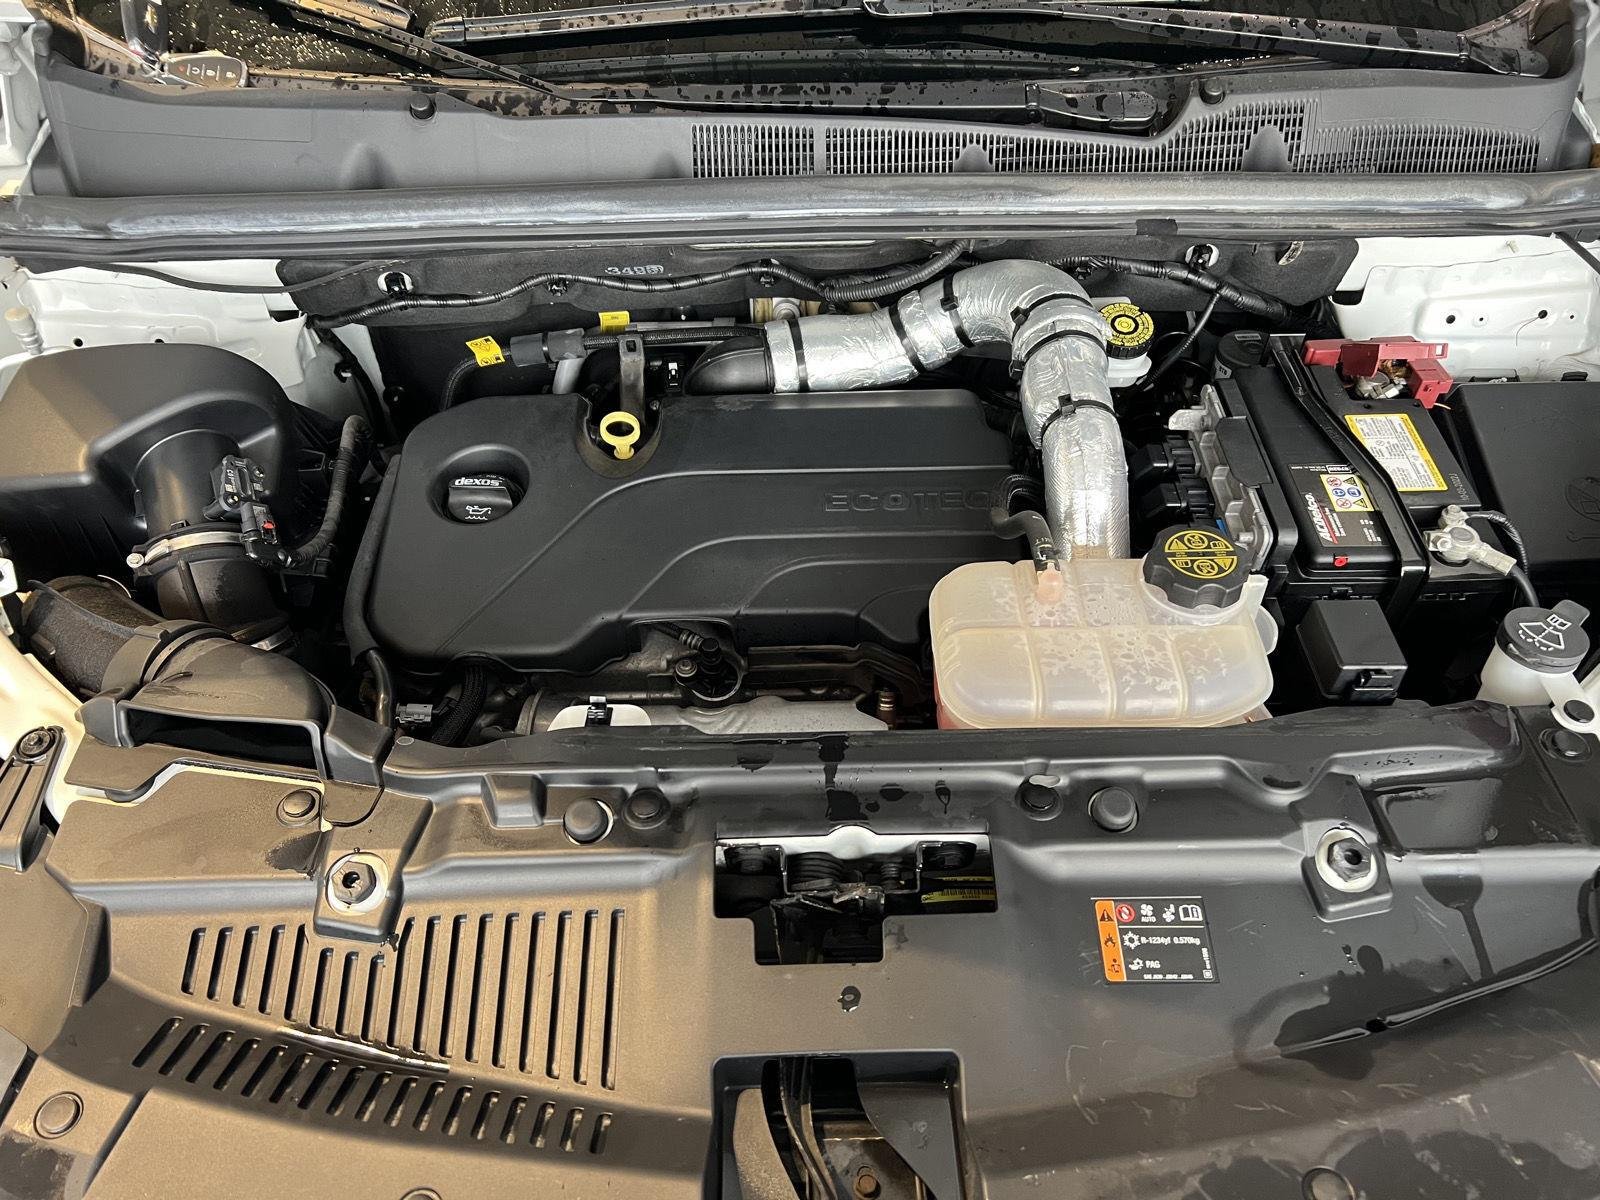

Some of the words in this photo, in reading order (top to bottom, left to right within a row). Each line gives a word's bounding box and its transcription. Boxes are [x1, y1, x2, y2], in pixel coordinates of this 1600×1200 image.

[454, 477, 500, 487] dexos
[824, 491, 990, 512] ECOTEC
[1145, 960, 1161, 968] PAG
